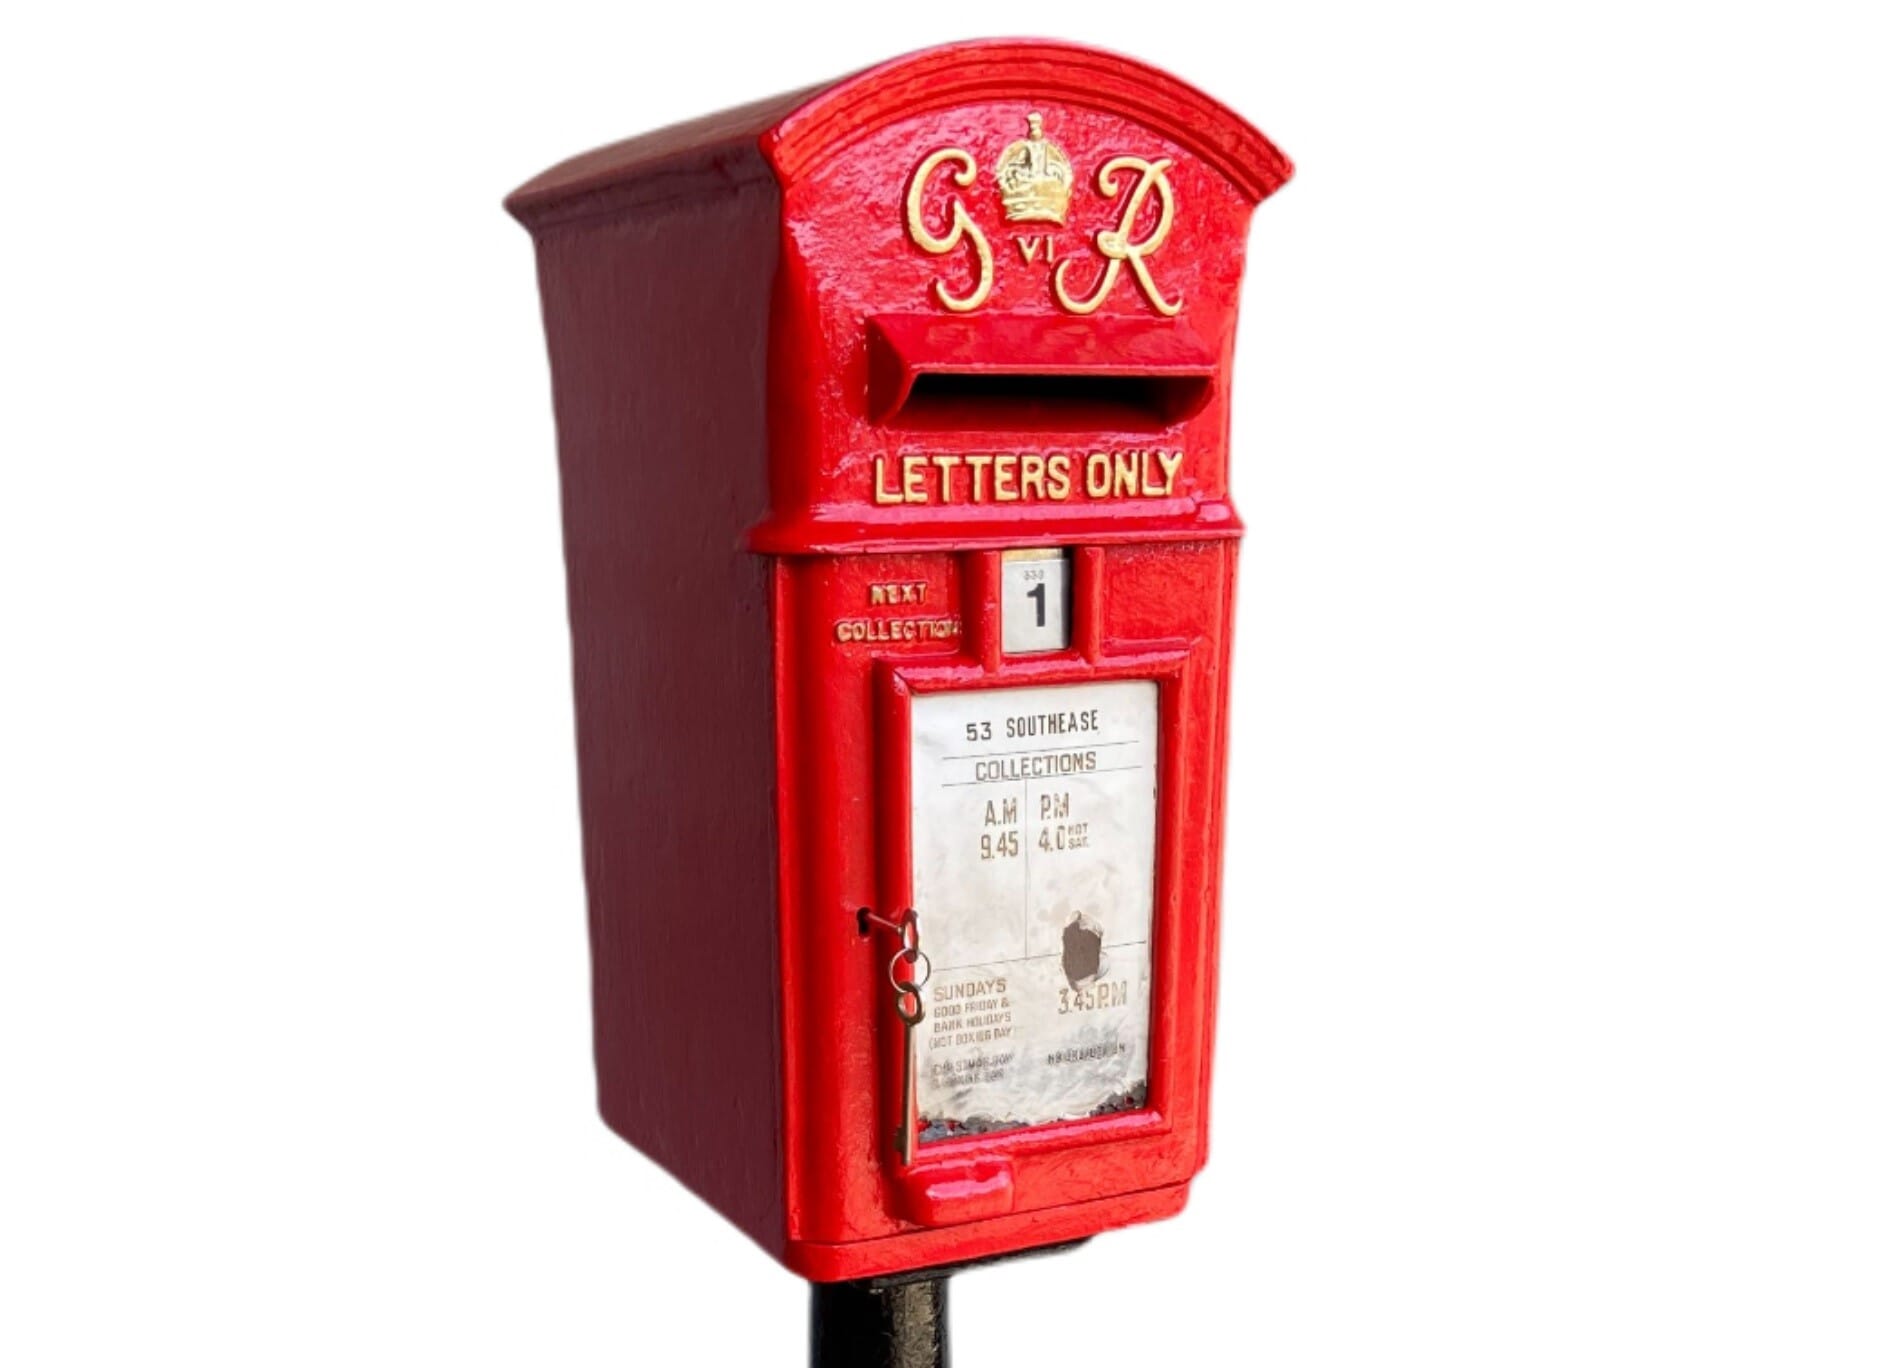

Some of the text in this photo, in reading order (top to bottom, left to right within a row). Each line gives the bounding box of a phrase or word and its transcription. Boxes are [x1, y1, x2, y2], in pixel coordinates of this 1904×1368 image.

[907, 148, 1183, 316] G VI R
[875, 452, 1183, 504] LETTERS ONLY
[871, 583, 928, 605] NEXT
[1026, 583, 1045, 627] 1
[966, 709, 1099, 741] 53 SOUTHEASE
[975, 751, 1096, 781] COLLECTIONS
[985, 798, 1017, 826] A.M
[981, 831, 1018, 860] 9.45
[1039, 825, 1065, 852] 4.0
[934, 977, 1006, 1002] SUNDAYS
[934, 1004, 961, 1018] GOOD
[965, 999, 998, 1013] FRIDAY
[934, 1011, 1011, 1033] BANK HOLIDAYS
